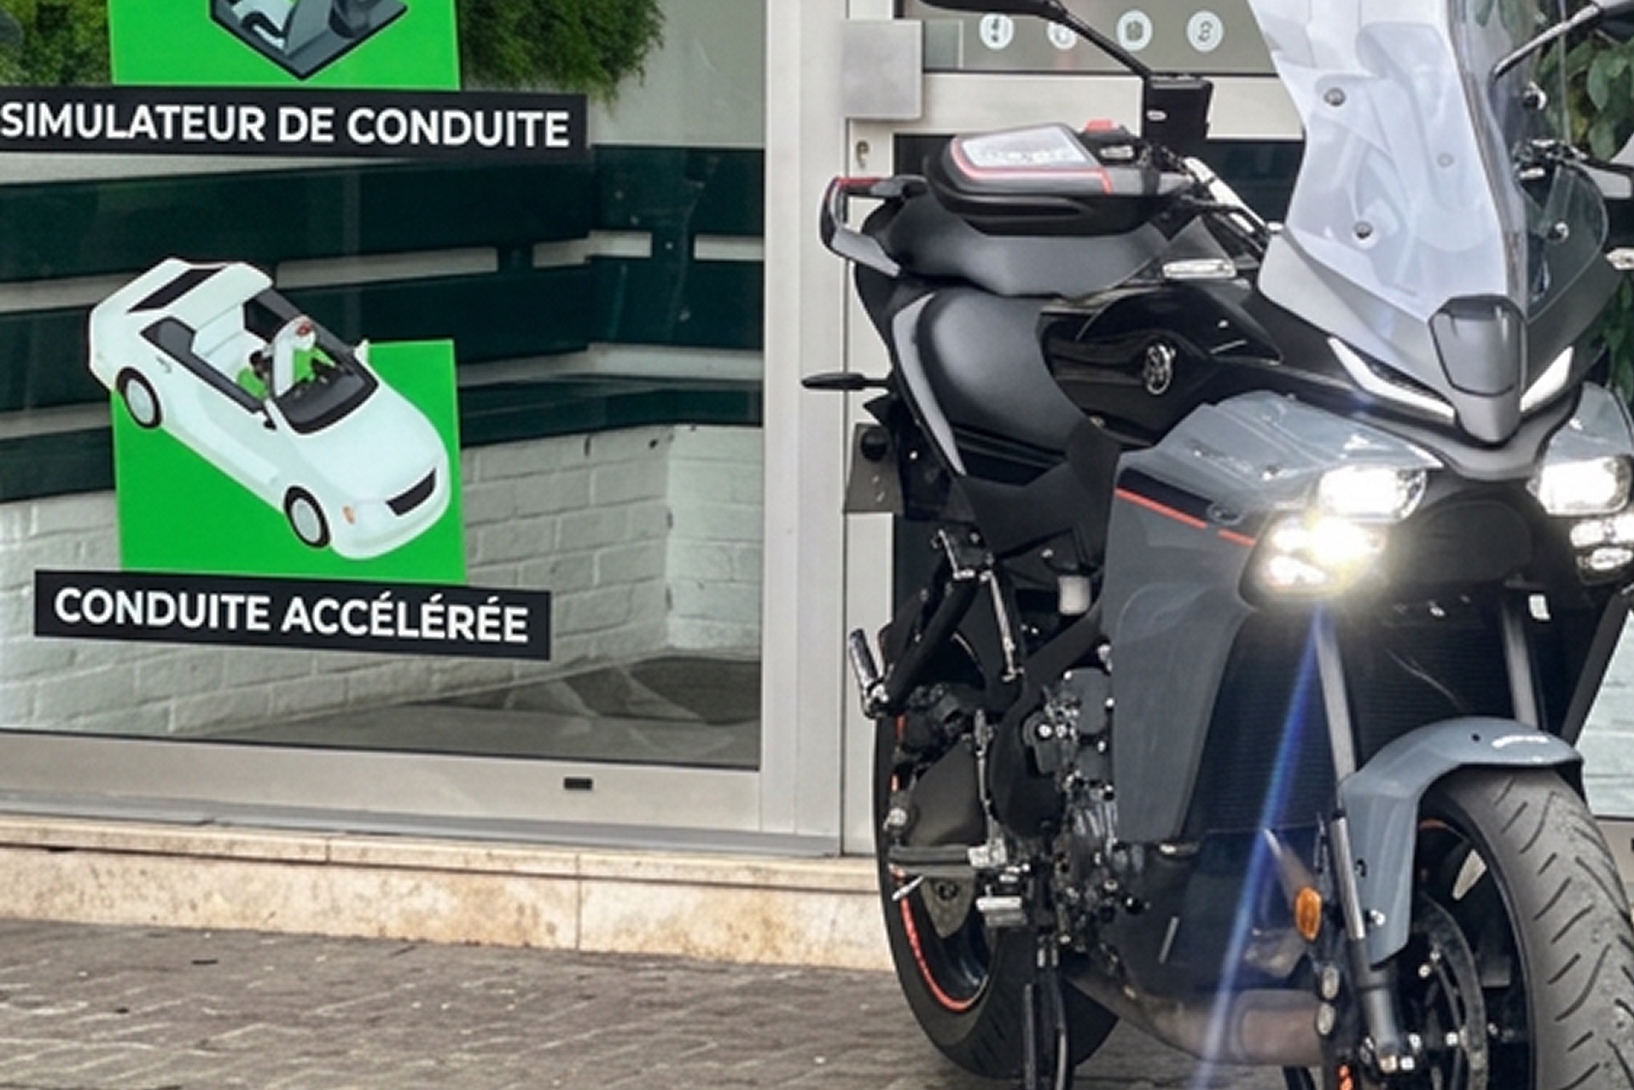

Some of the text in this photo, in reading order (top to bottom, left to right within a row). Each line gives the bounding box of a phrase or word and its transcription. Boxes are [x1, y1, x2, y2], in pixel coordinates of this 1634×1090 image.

[0, 103, 570, 148] SIMULATEUR DE CONDUITE
[53, 585, 529, 644] CONDUITE ACCÉLÉRÉE
